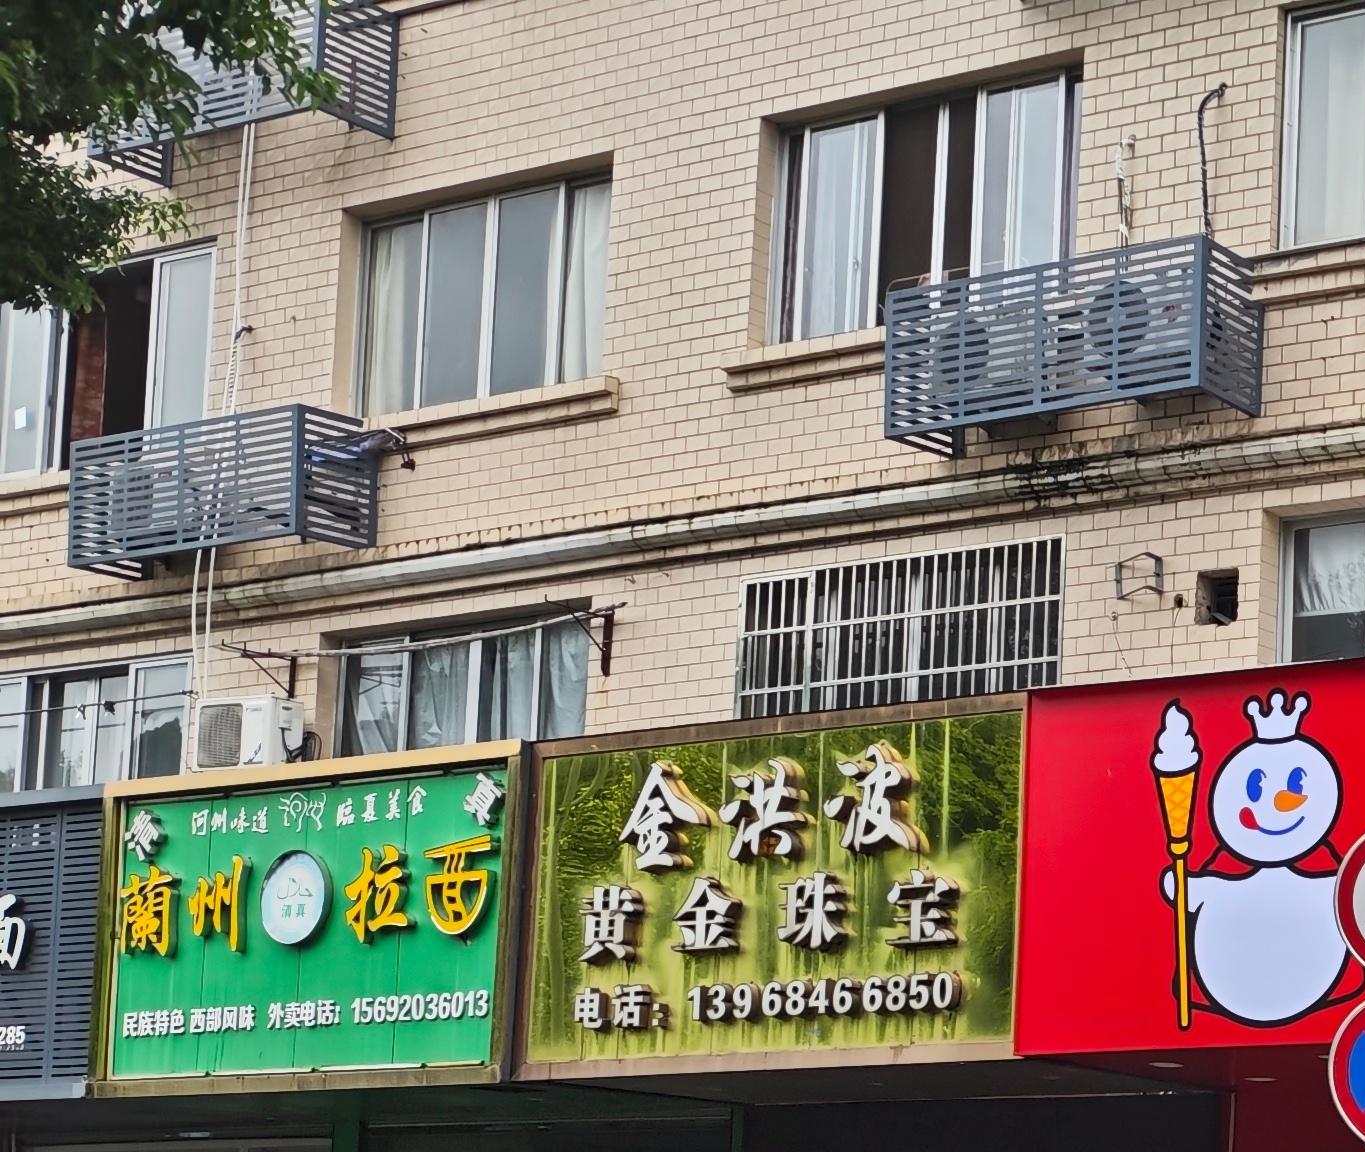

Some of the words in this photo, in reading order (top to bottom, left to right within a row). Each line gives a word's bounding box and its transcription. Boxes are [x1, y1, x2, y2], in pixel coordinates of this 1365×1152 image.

[463, 772, 504, 826] 真
[619, 743, 925, 869] 金洪波
[578, 872, 960, 963] 黄金珠宝
[122, 1009, 186, 1037] 民族特色
[189, 1004, 256, 1034] 西部风味
[351, 990, 489, 1026] 15692036013
